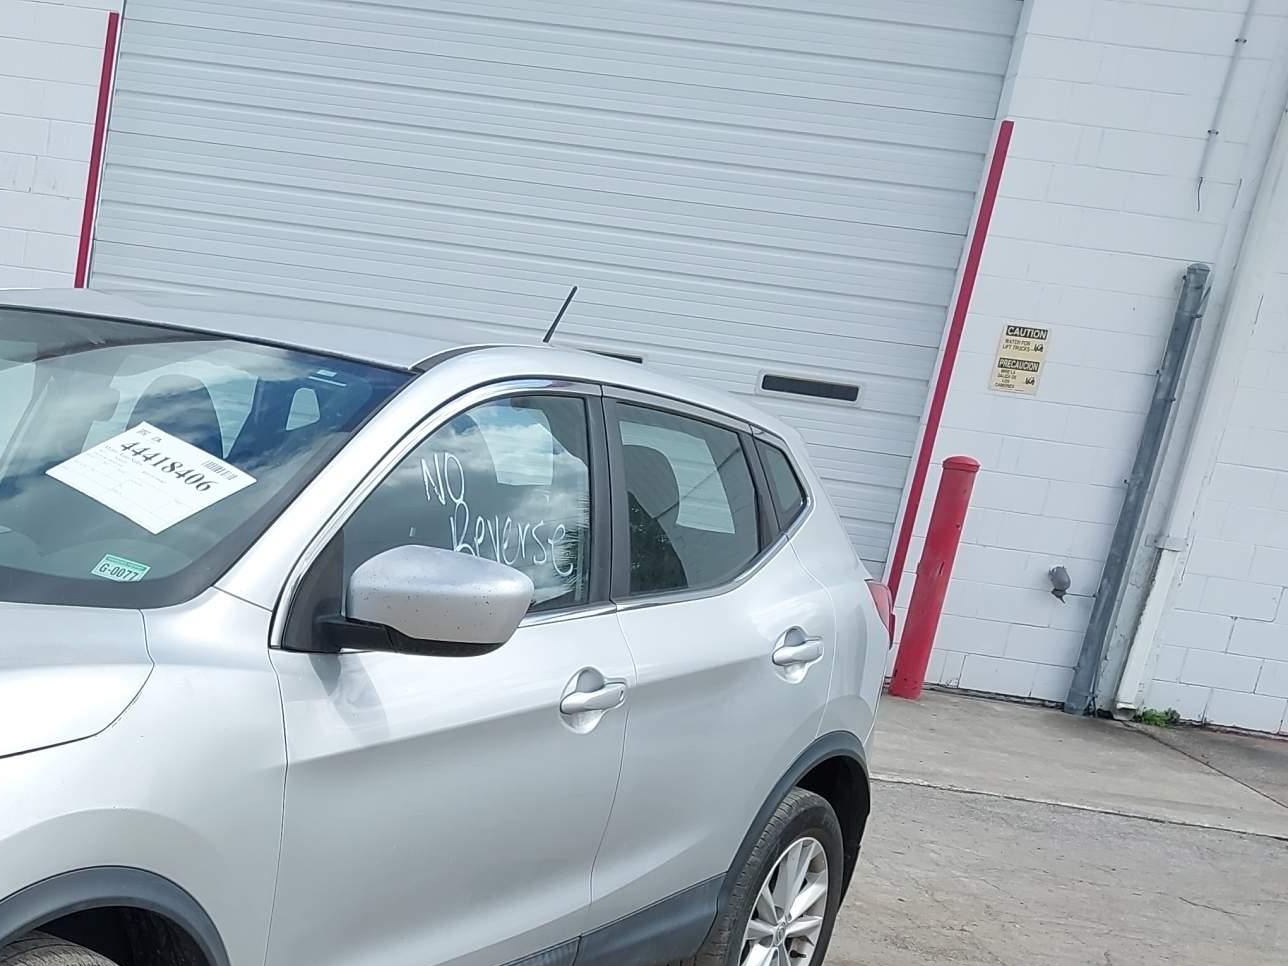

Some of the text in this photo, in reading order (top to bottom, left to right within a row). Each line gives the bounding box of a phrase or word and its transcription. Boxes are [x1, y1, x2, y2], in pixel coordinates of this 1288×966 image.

[1007, 326, 1047, 340] CAUTION
[120, 441, 213, 492] 44418406
[421, 452, 465, 505] NO
[99, 563, 139, 581] G-0077
